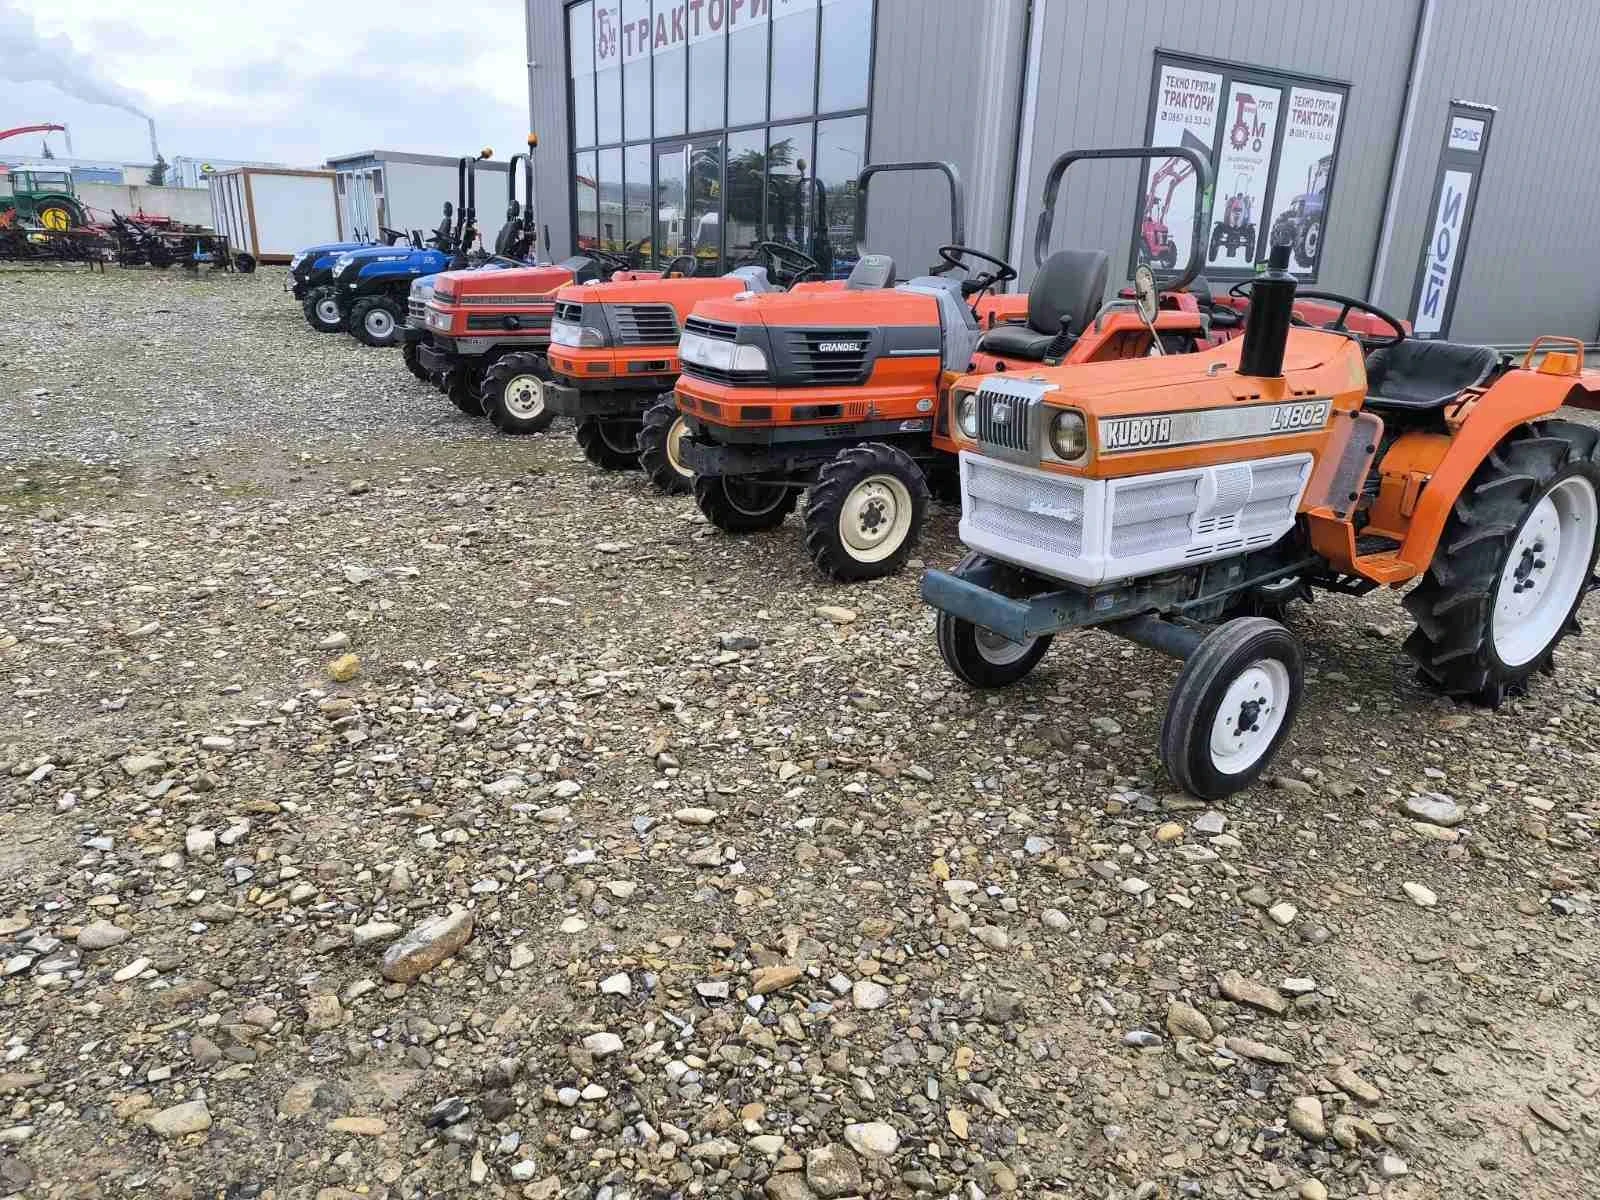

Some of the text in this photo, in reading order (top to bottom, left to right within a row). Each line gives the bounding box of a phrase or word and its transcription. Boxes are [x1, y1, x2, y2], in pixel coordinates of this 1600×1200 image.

[1166, 75, 1190, 90] ТЕХНО
[1165, 90, 1215, 112] ТРАКТОРИ
[1292, 109, 1334, 128] ТРАКТОРИ
[819, 343, 861, 352] GRANDEL
[1105, 403, 1325, 448] KUBOTA L1802
